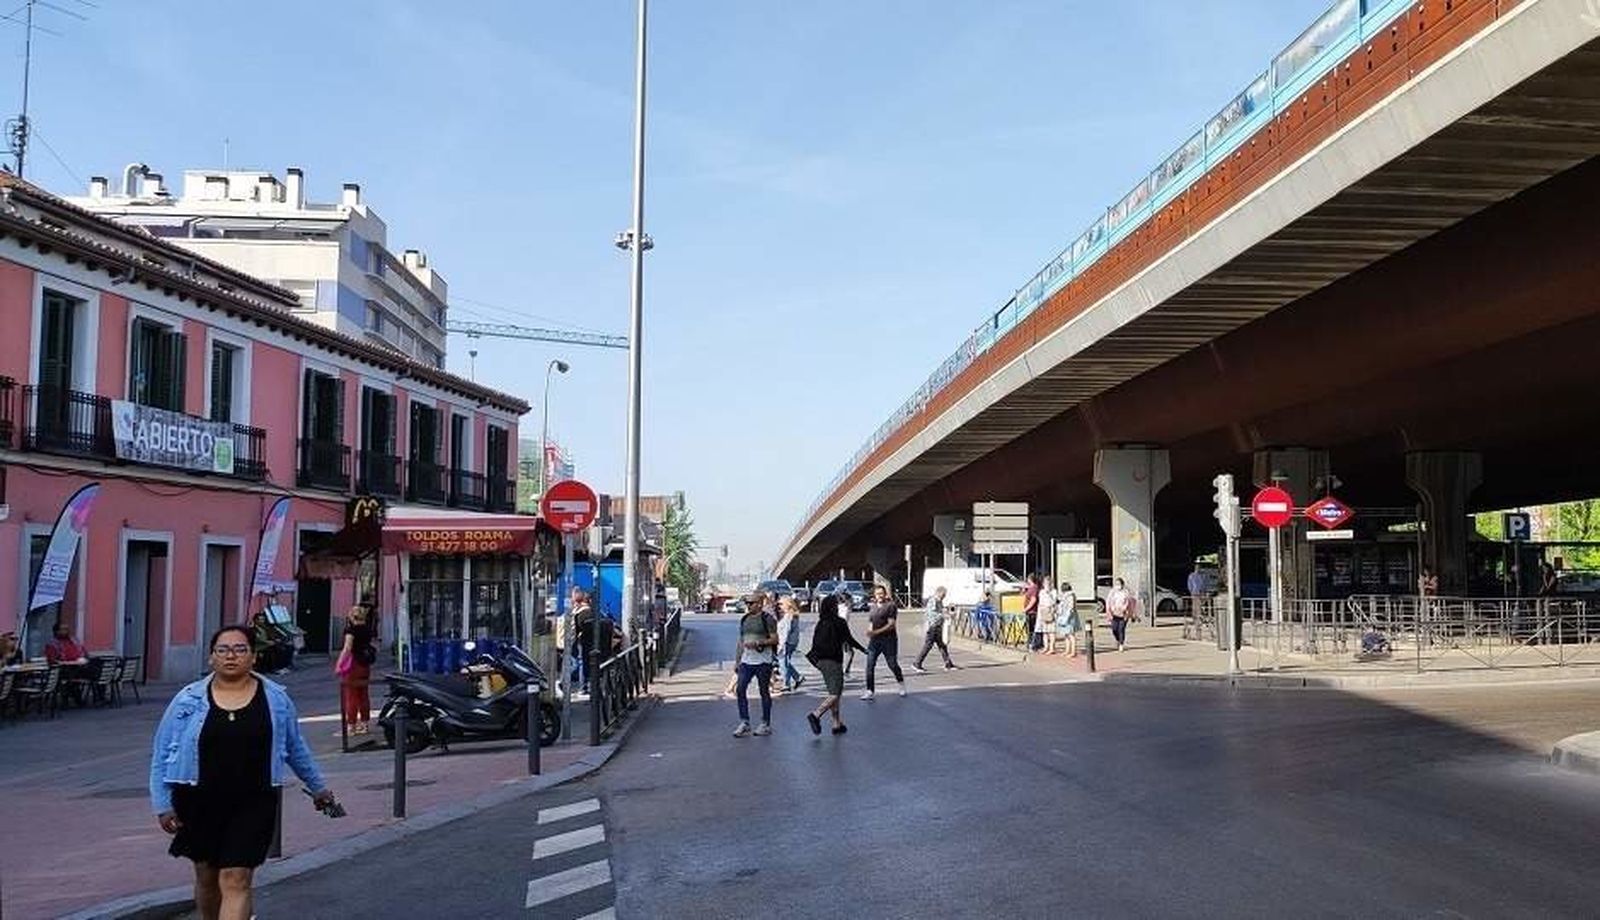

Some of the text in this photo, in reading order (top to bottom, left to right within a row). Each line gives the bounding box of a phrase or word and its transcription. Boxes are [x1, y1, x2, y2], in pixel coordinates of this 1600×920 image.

[136, 419, 213, 457] ABIERTO
[1510, 516, 1525, 538] P
[406, 531, 513, 541] TOLDOS ROAMA
[437, 541, 460, 551] 477
[464, 541, 477, 551] 18
[480, 541, 498, 551] 00
